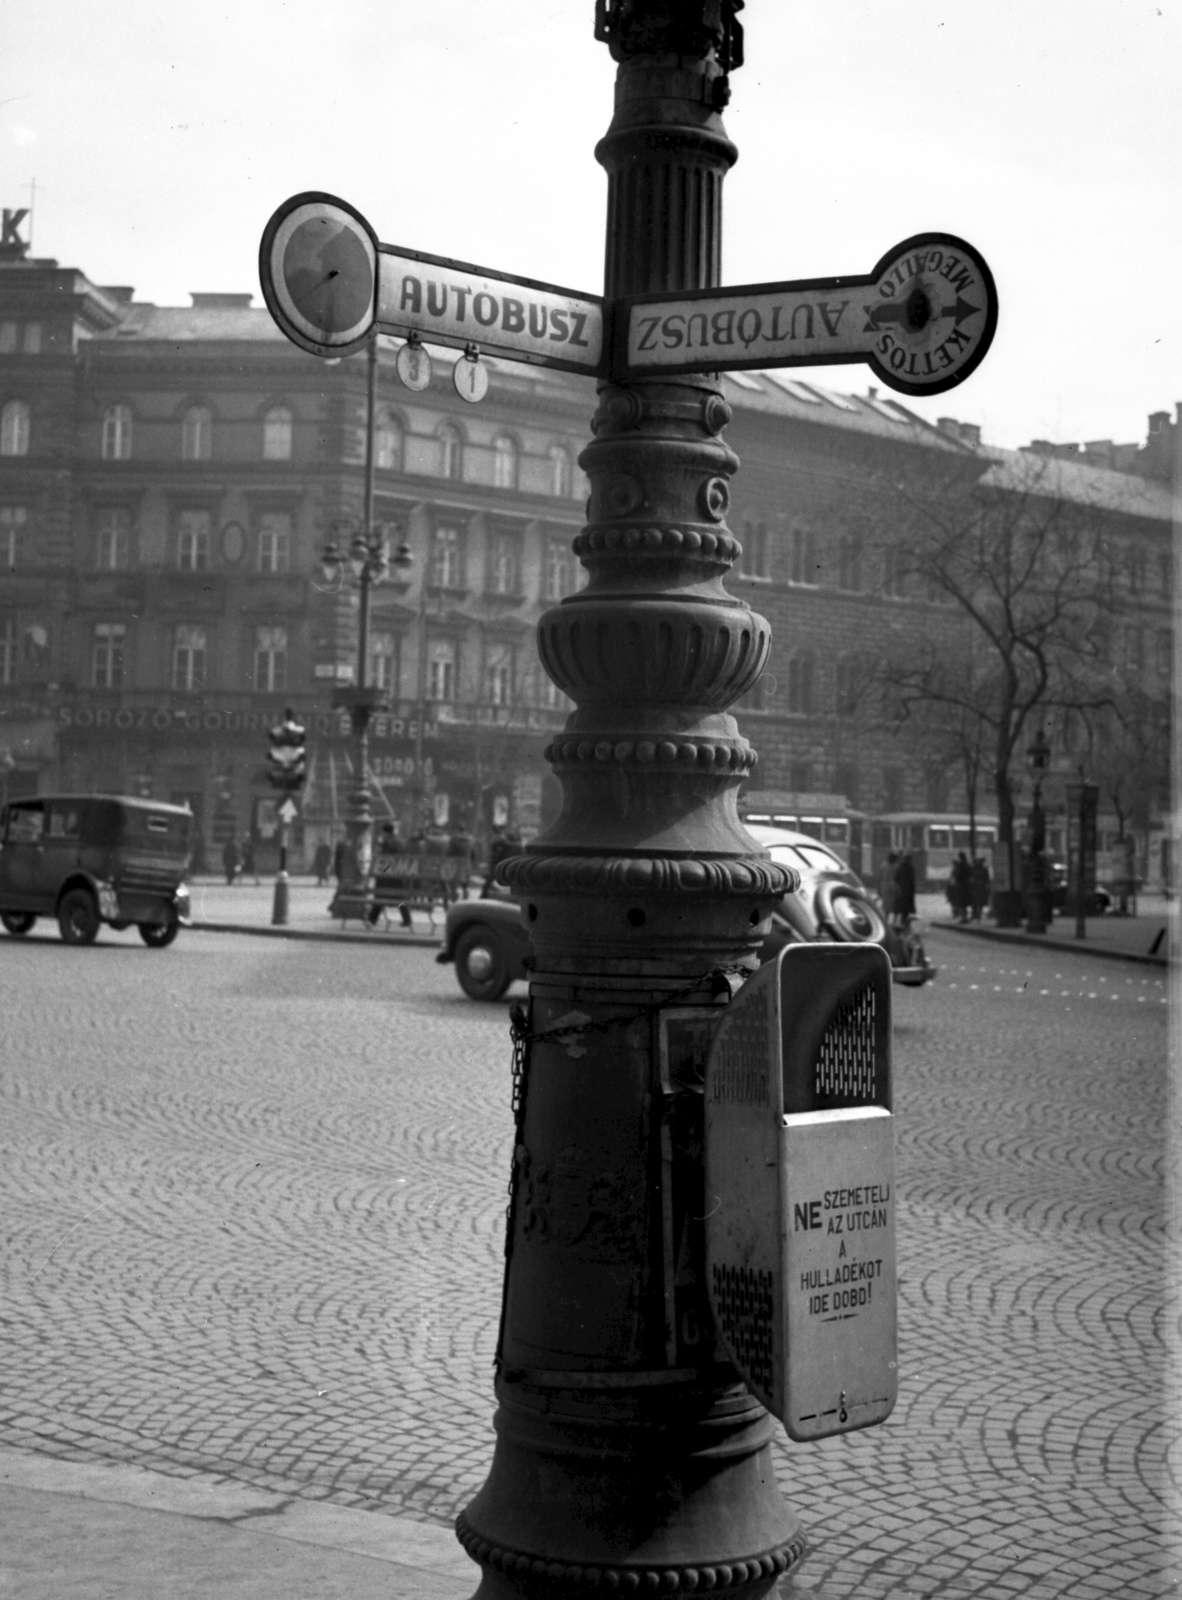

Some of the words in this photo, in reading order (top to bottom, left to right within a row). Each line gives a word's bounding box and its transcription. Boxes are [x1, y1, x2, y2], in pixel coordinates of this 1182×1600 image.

[636, 300, 850, 352] AUTÓBUSZ
[407, 354, 420, 382] 3
[468, 366, 477, 394] 1
[794, 1201, 822, 1232] NE
[824, 1184, 890, 1210] SZEMETELJ
[827, 1215, 843, 1235] AZ
[846, 1205, 887, 1231] UTCÁN
[839, 1239, 847, 1258] A
[800, 1257, 883, 1291] HULLADÉKOT
[809, 1294, 830, 1316] IDE
[833, 1281, 872, 1310] DOBD!
